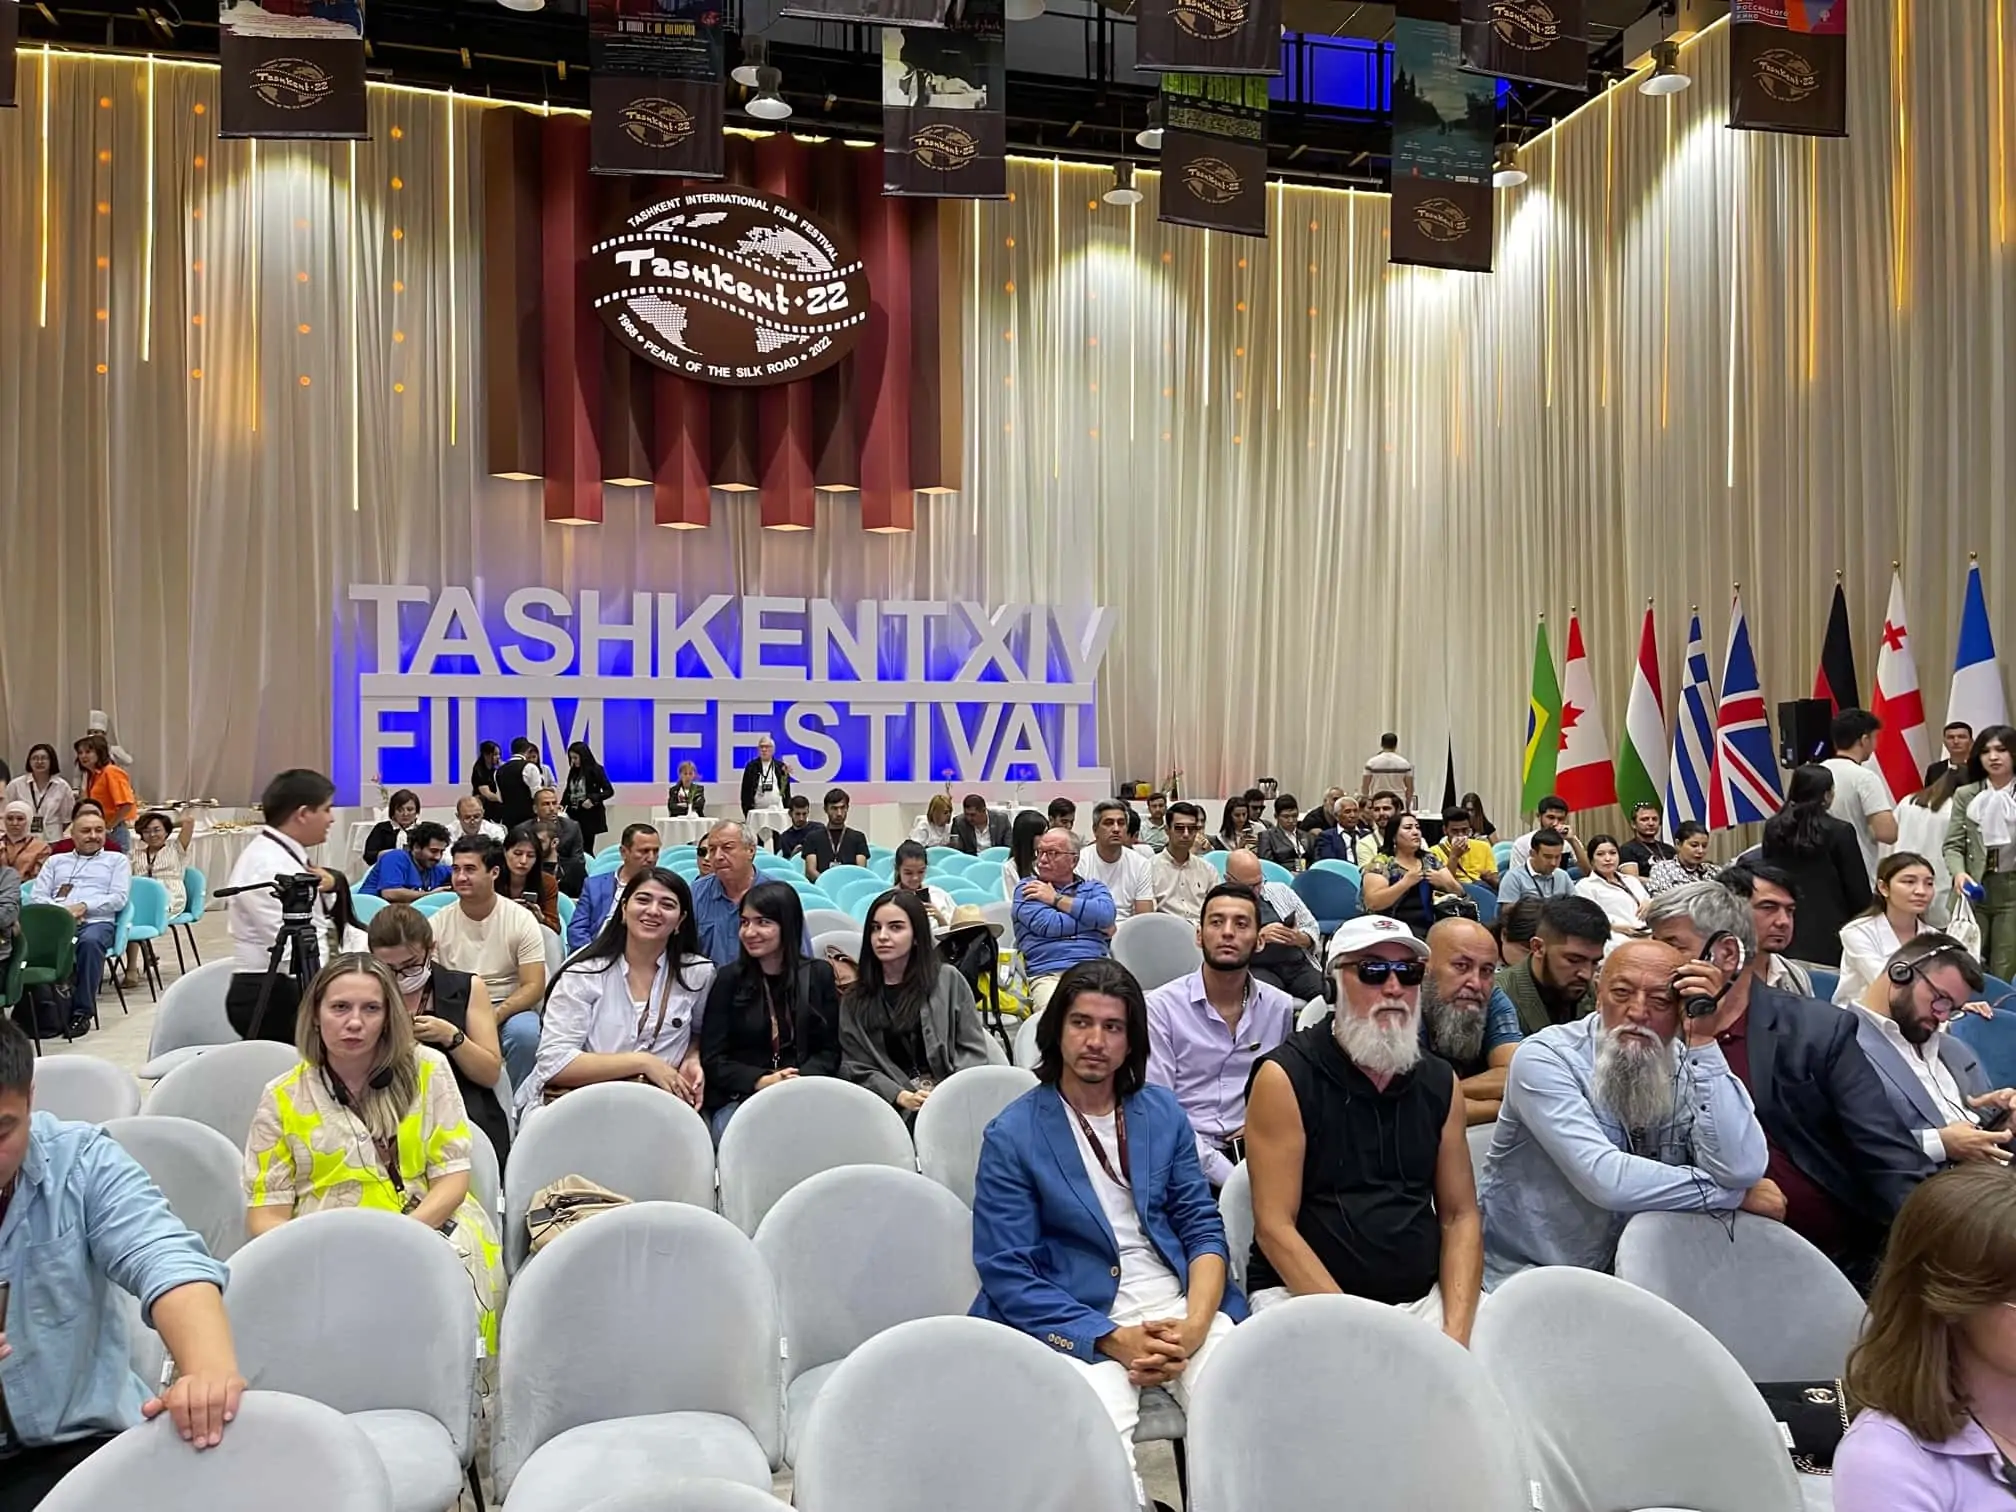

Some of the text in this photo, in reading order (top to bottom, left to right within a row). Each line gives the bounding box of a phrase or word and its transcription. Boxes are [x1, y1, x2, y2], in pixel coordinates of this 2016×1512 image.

[627, 193, 840, 262] TASHKENT INTERNATIONAL FILM FESTIVAL
[615, 248, 849, 315] Tashkent 22
[617, 312, 833, 378] 1968 PEARL OF THE SILK ROAD 2022
[360, 697, 1111, 784] FILM FESTIVAL
